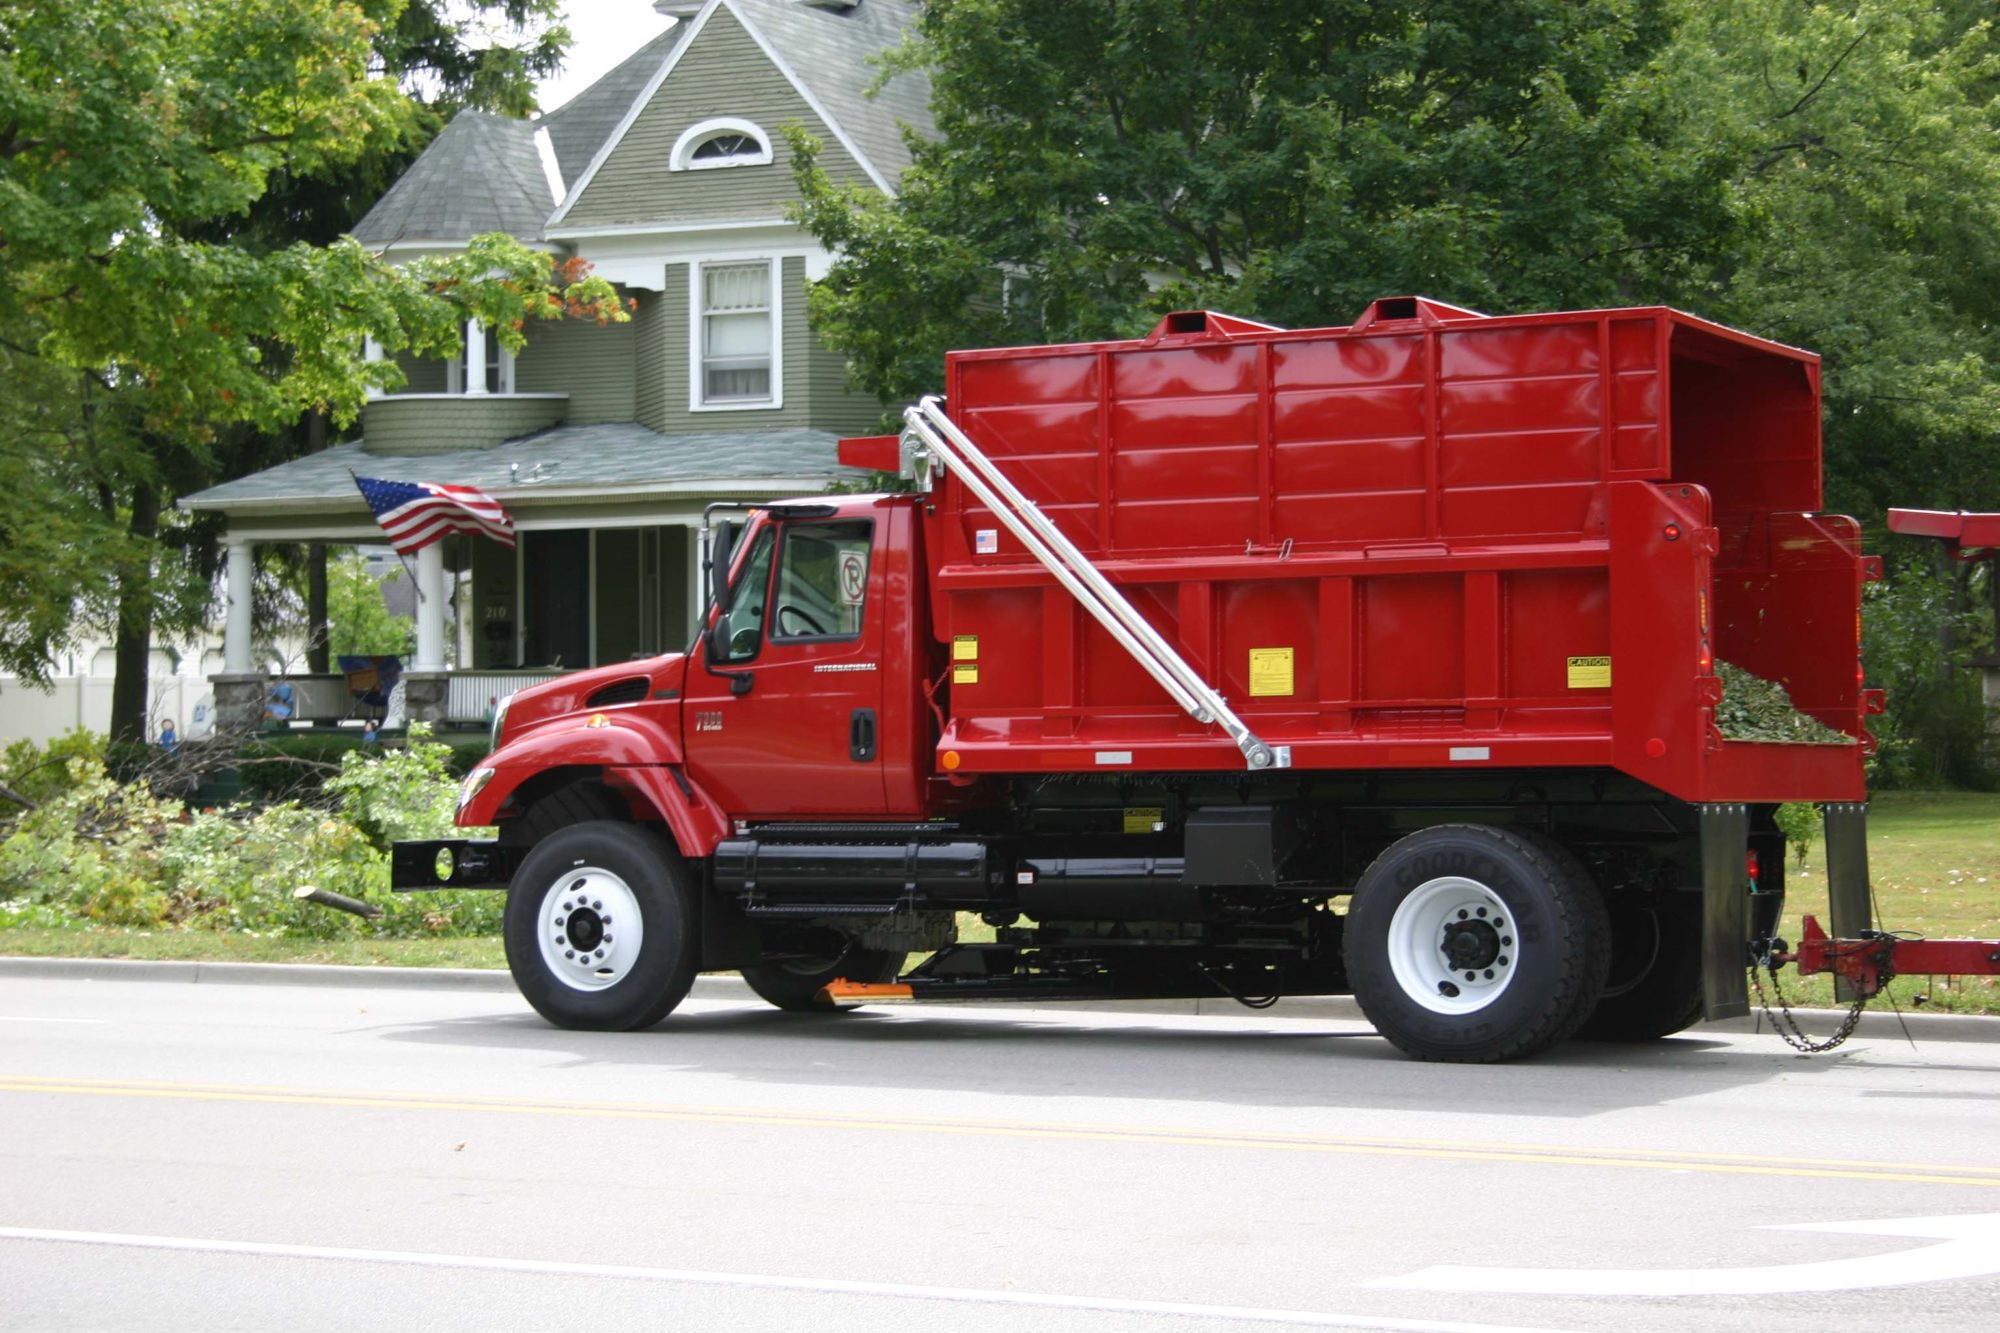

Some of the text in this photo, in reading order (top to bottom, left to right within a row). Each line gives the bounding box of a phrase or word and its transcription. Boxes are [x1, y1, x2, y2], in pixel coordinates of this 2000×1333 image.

[485, 606, 507, 619] 210
[813, 663, 877, 672] INTERNATIONAL
[1569, 658, 1609, 667] CAUTION
[1393, 851, 1541, 944] GOODYEAR
